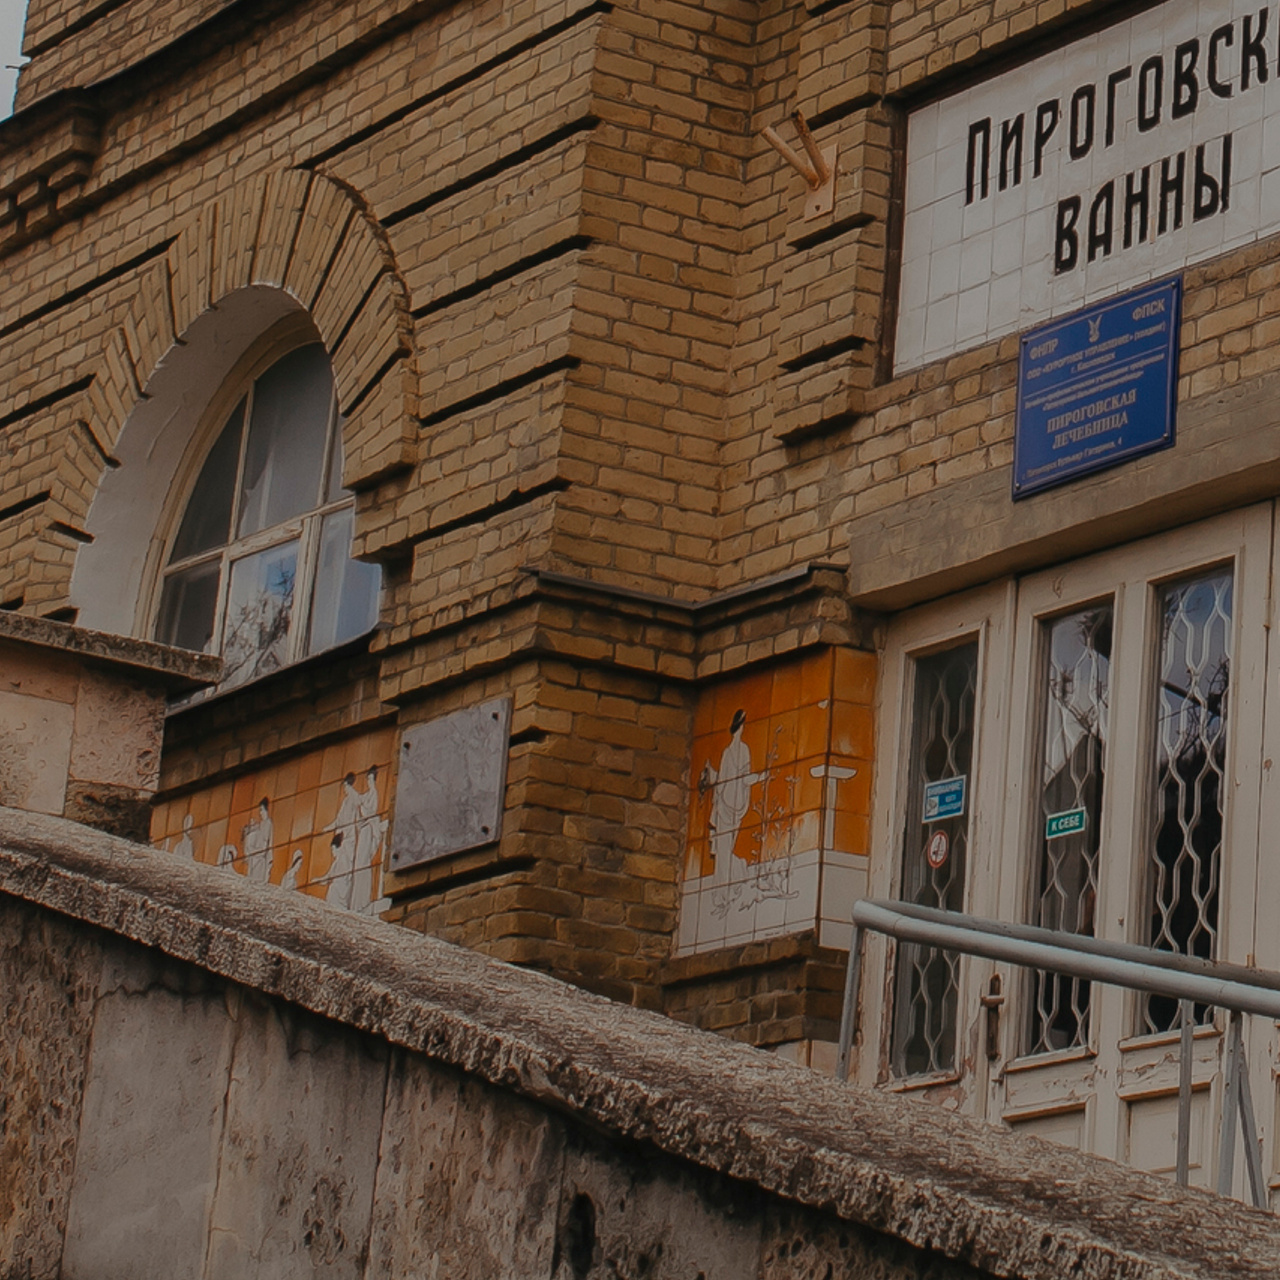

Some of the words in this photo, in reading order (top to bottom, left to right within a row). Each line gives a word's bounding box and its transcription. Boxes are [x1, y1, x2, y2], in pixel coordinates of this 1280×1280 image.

[1054, 132, 1233, 276] ВАННЫ
[1132, 298, 1166, 321] ФПСК
[1029, 338, 1059, 360] ФНПР
[1047, 388, 1137, 433] ПИРОГОВСКАЯ
[1052, 410, 1129, 450] ЛЕЧЕБНИЦА
[1051, 820, 1058, 832] К
[1058, 815, 1080, 830] СЕБЕ
